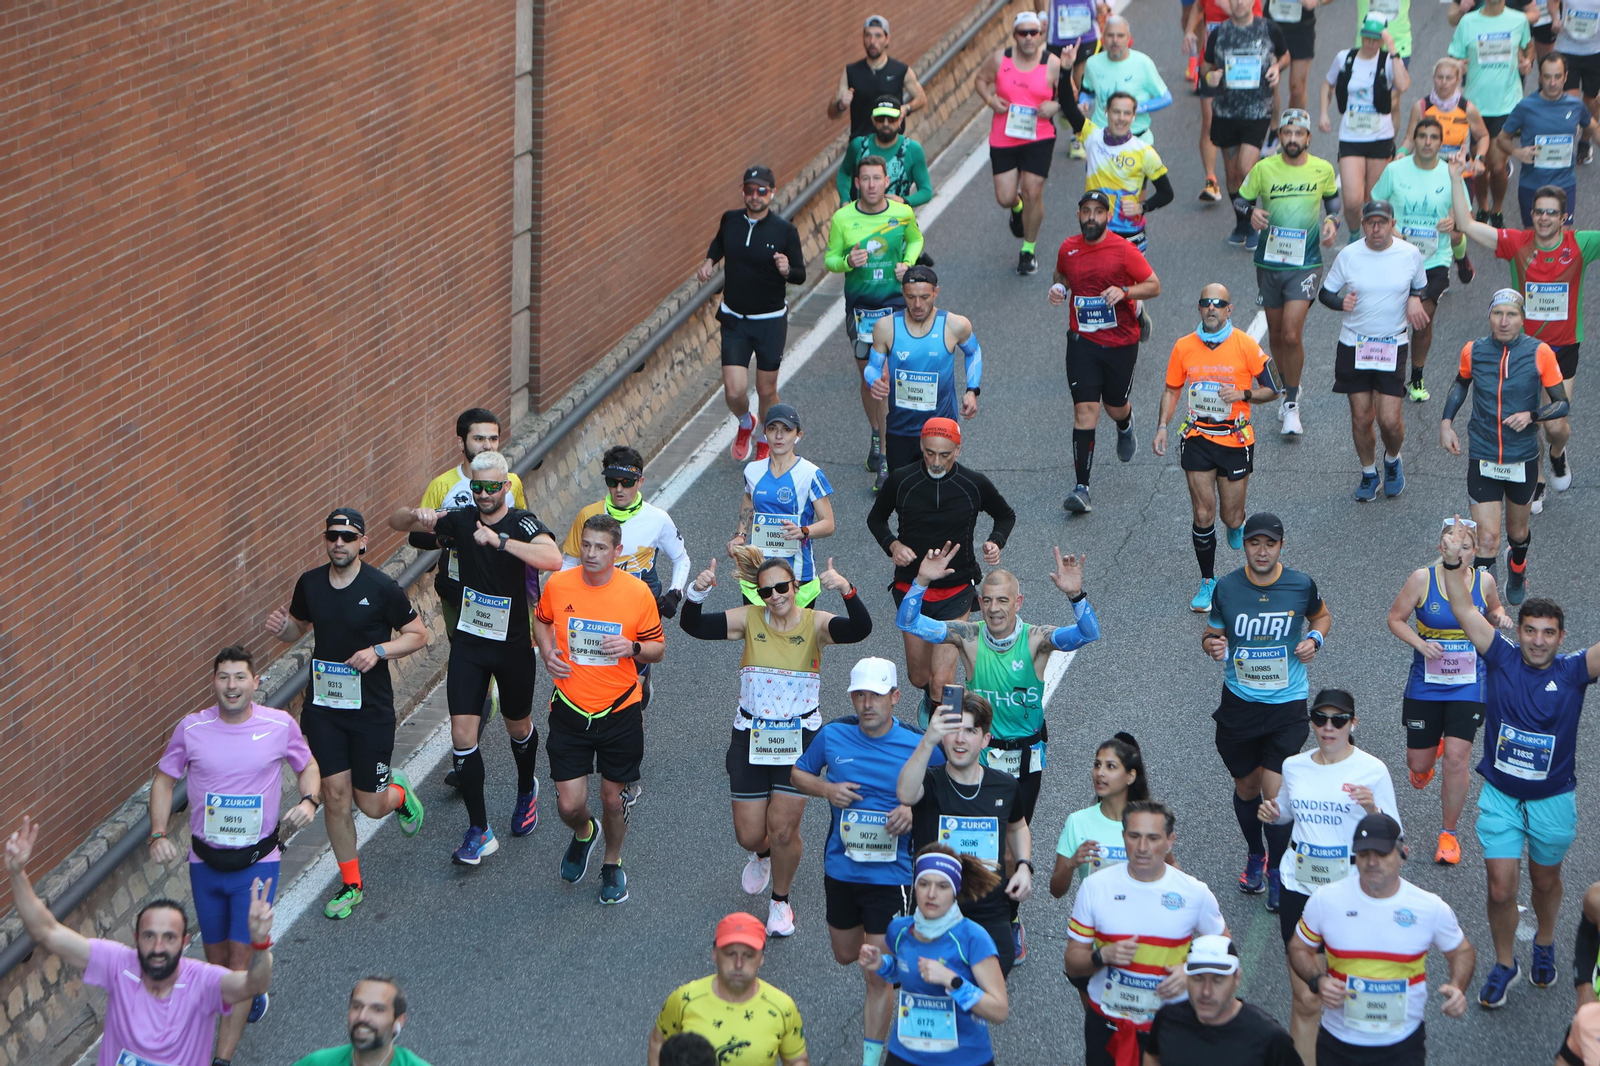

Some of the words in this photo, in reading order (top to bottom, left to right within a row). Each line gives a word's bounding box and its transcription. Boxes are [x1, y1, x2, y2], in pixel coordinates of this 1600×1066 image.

[477, 597, 504, 606] ZURICH
[476, 610, 491, 619] 9362
[587, 623, 614, 632] ZURICH
[1252, 650, 1279, 658] ZURICH
[1517, 734, 1547, 745] ZURICH
[224, 815, 242, 823] 9819
[1297, 813, 1342, 825] MADRID
[961, 821, 991, 829] ZURICH
[860, 832, 877, 840] 9072
[960, 839, 978, 847] 3696
[1312, 848, 1342, 856] ZURICH
[1123, 977, 1156, 988] ZURICH
[1368, 982, 1400, 991] ZURICH
[917, 998, 947, 1009] ZURICH
[917, 1018, 935, 1027] 6175
